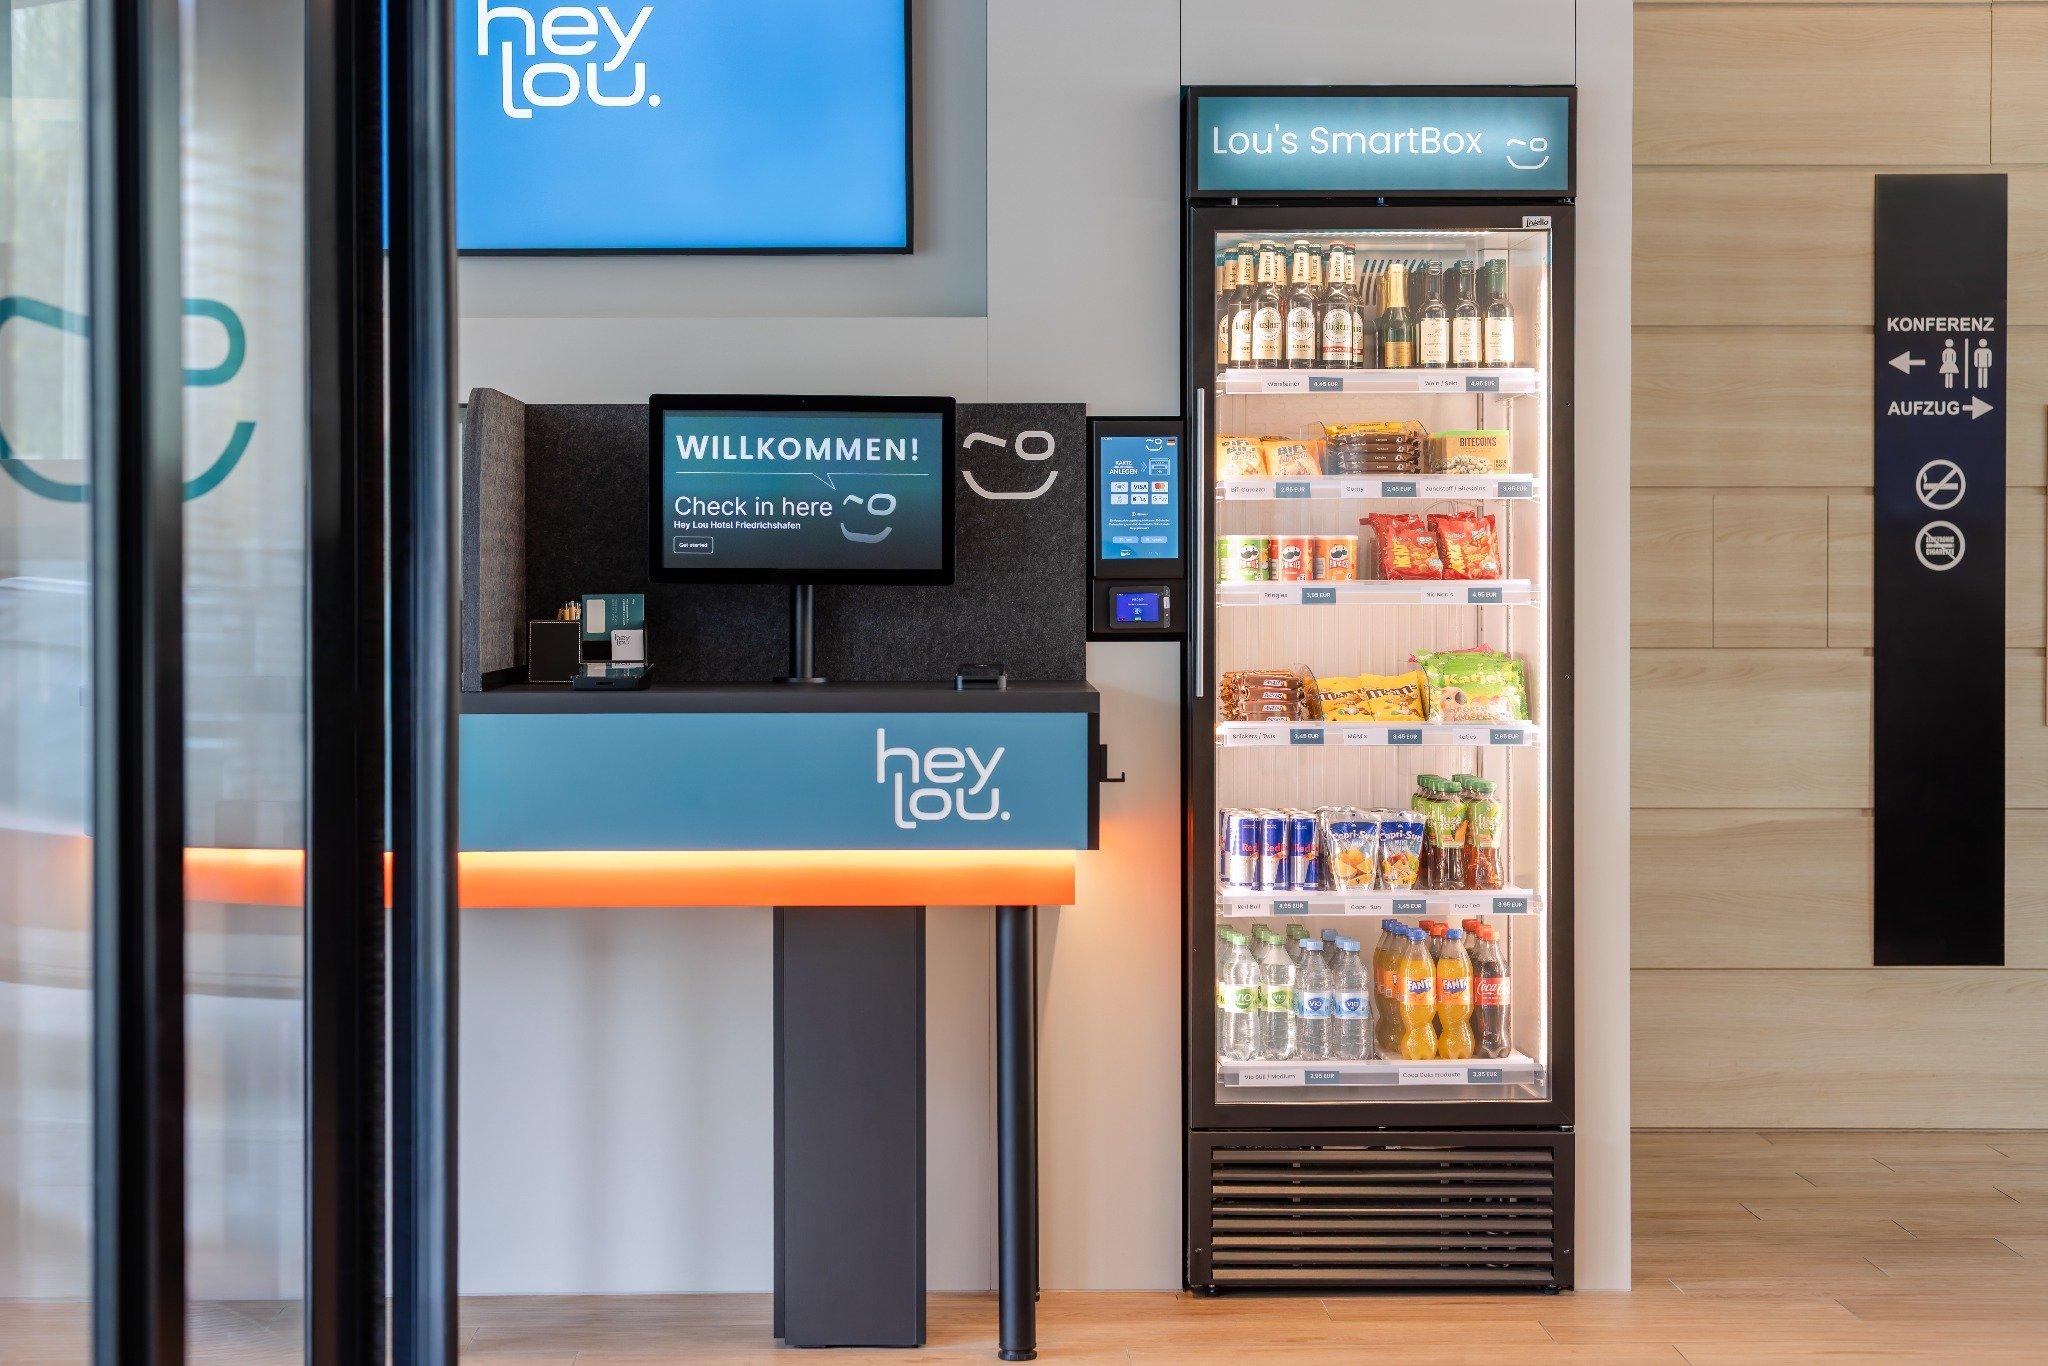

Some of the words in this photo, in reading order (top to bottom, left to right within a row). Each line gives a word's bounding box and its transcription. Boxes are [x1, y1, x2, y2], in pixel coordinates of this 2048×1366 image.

[477, 0, 654, 72] hey
[502, 41, 662, 119] lou.
[1213, 124, 1298, 155] Lou's
[1310, 126, 1483, 155] SmartBox
[1887, 317, 1995, 332] KONFERENZ
[1485, 380, 1496, 388] EUR
[1887, 401, 1960, 416] AUFZUG
[676, 434, 919, 462] WILLKOMMEN!
[1459, 437, 1497, 447] BITECOINS
[674, 495, 747, 516] Check
[755, 496, 774, 516] in
[782, 496, 833, 517] here
[674, 520, 690, 530] Hey
[692, 520, 708, 529] Lou
[710, 520, 733, 529] Hotel
[735, 521, 801, 530] Friedrichshafen
[876, 728, 1005, 795] hey
[894, 772, 1011, 829] lou.
